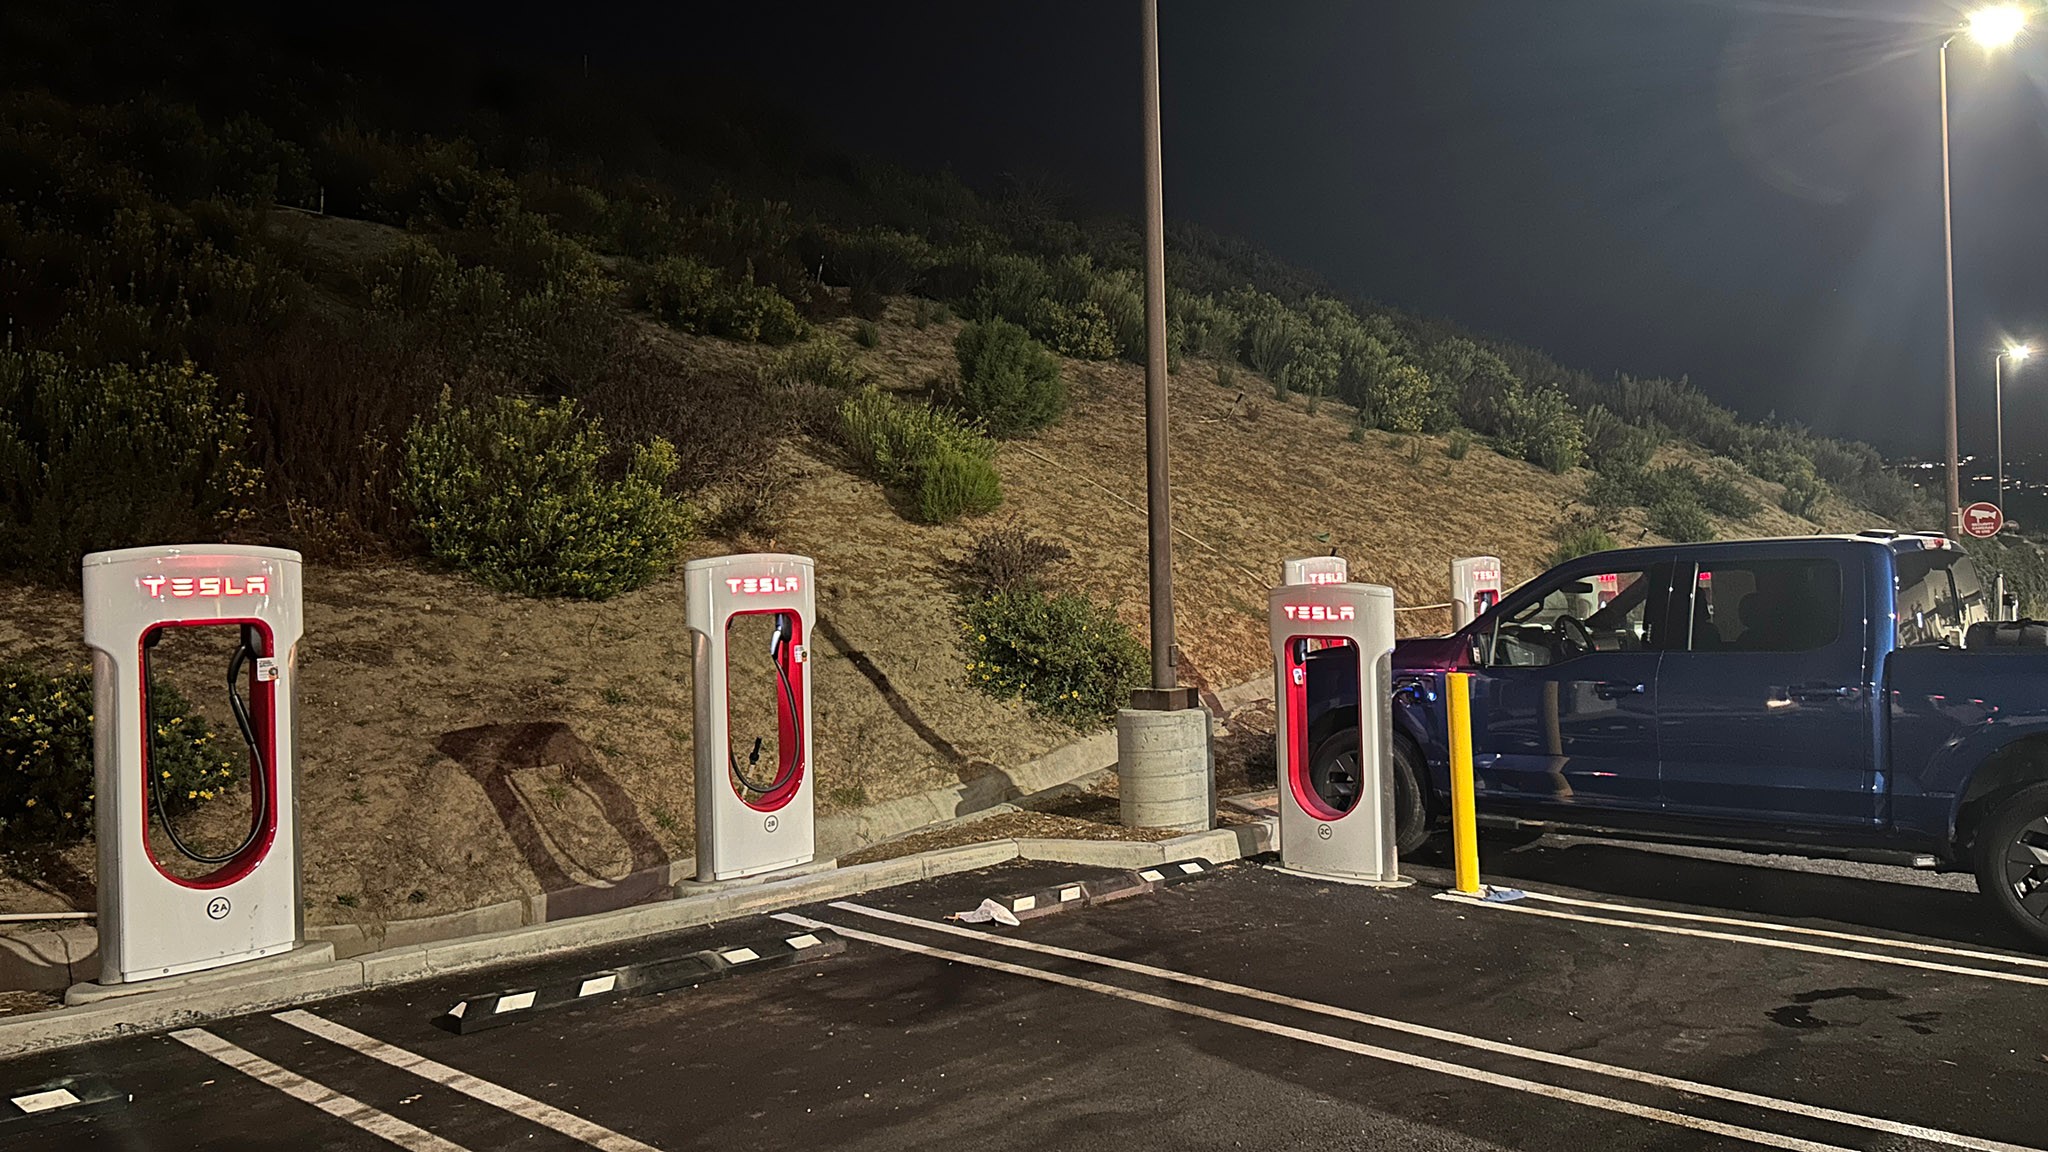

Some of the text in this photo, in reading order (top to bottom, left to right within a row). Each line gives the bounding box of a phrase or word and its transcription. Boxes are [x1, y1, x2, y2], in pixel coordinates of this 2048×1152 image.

[1309, 573, 1343, 585] TESLA
[1472, 570, 1499, 580] TESLA
[141, 577, 267, 598] TESLA
[725, 577, 799, 594] TESLA
[1284, 606, 1355, 621] TESLA
[1320, 828, 1330, 836] 2C
[212, 903, 229, 913] 2A
